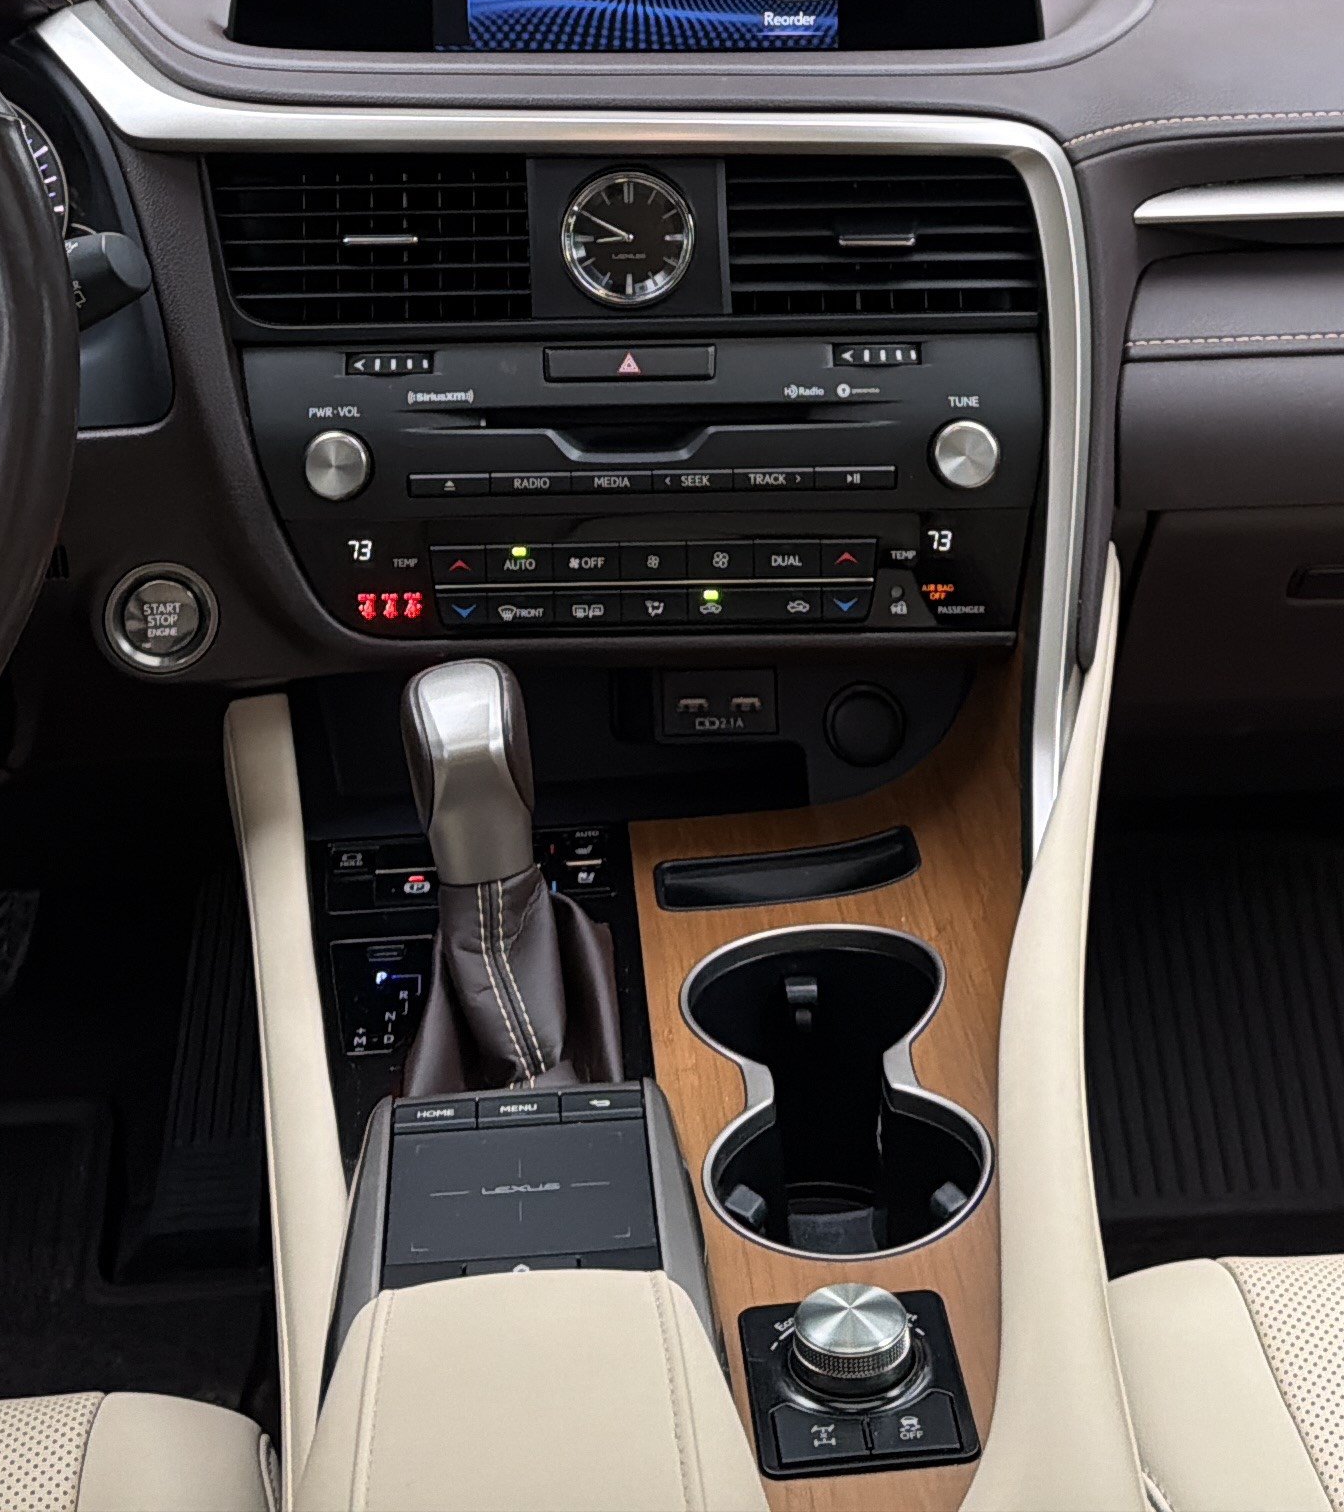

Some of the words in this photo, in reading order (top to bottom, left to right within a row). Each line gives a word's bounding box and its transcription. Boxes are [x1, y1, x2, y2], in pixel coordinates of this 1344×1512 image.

[764, 12, 817, 27] Reorder
[798, 386, 825, 396] Radio
[948, 395, 980, 408] TUNE
[513, 477, 550, 490] RADIO
[593, 476, 631, 488] MEDIA
[680, 475, 710, 487] SEEK
[748, 473, 787, 485] TRACK
[927, 530, 953, 551] 73
[348, 540, 373, 561] 73
[890, 550, 916, 560] TEMP
[392, 558, 418, 568] TEMP
[503, 558, 536, 570] AUTO
[581, 557, 605, 569] OFF
[771, 555, 803, 567] DUAL
[921, 584, 936, 592] AIR
[929, 592, 946, 600] OFF
[143, 602, 181, 615] START
[516, 608, 544, 618] FRONT
[937, 605, 986, 615] PASSENGER
[147, 614, 178, 627] STOP
[147, 627, 178, 638] ENGINE
[375, 971, 388, 985] P
[398, 990, 409, 1000] R
[384, 1011, 396, 1022] N
[353, 1035, 367, 1047] M
[383, 1034, 395, 1044] D
[416, 1108, 455, 1119] HOME
[499, 1102, 538, 1115] MENU
[481, 1182, 561, 1196] LEXUS
[899, 1430, 924, 1440] OFF
